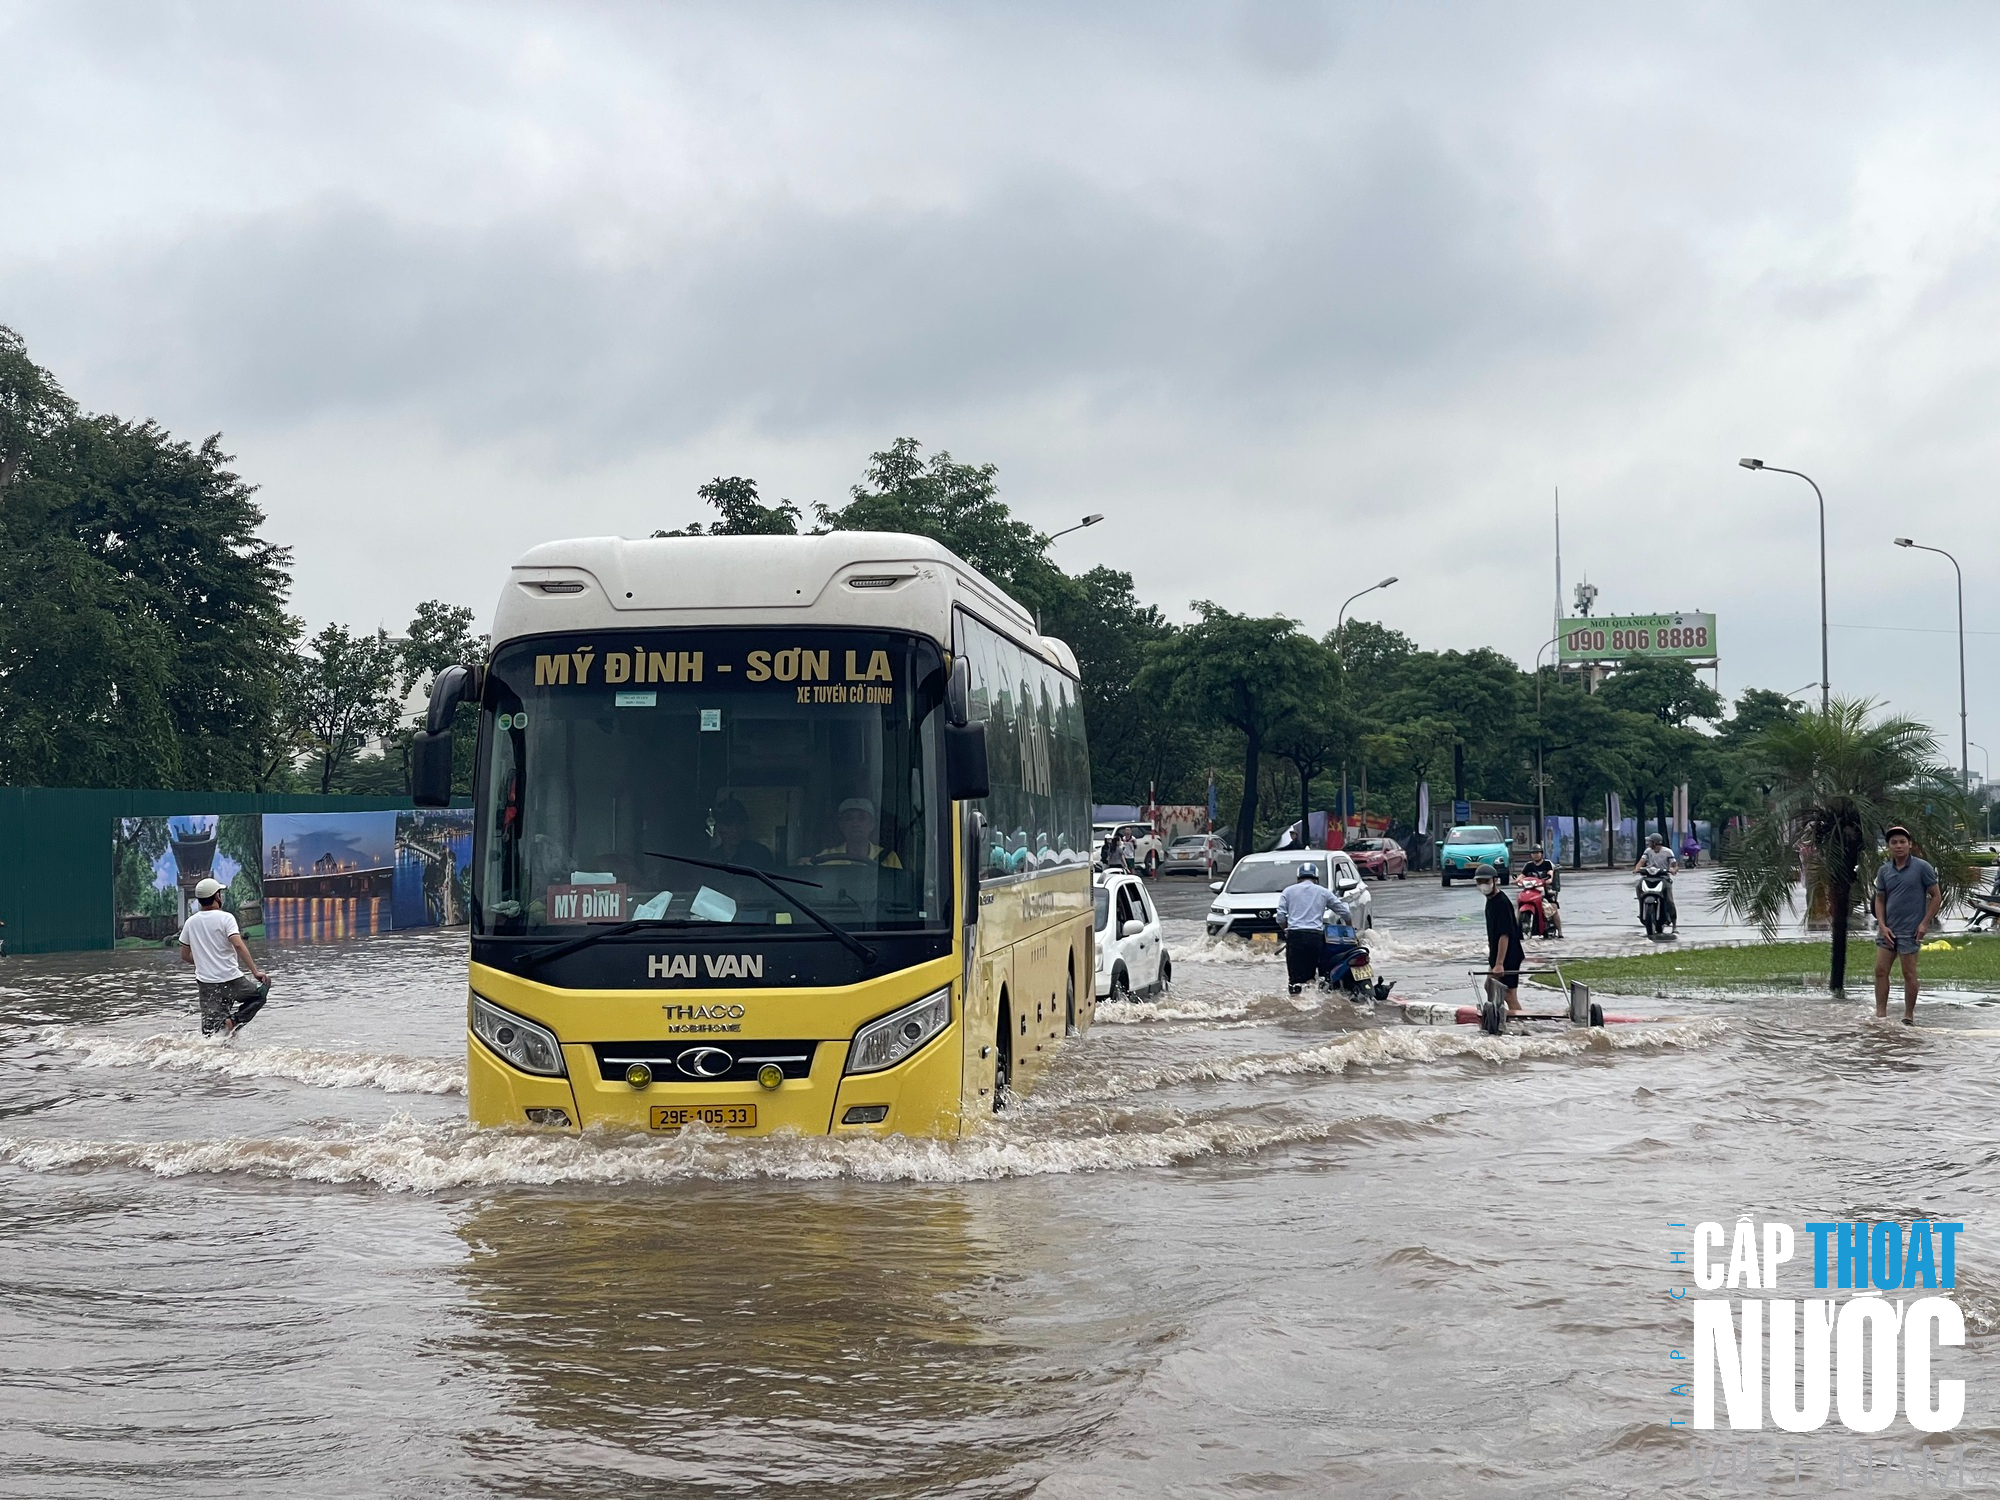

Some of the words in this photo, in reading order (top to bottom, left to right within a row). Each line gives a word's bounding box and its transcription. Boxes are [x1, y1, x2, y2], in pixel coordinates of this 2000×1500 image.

[1567, 629, 1605, 651] 090
[1612, 629, 1650, 650] 806
[1656, 626, 1708, 649] 8888
[534, 645, 596, 686] MỸ
[604, 645, 704, 684] ĐÌNH
[746, 647, 830, 682] SƠN
[845, 650, 893, 681] LA
[797, 686, 811, 704] XE
[554, 890, 578, 919] MỸ
[582, 888, 620, 918] ĐÌNH
[648, 954, 697, 978] HAI
[703, 954, 763, 978] VAN
[662, 1004, 745, 1020] THACO
[668, 1023, 742, 1033] MOBIHOME
